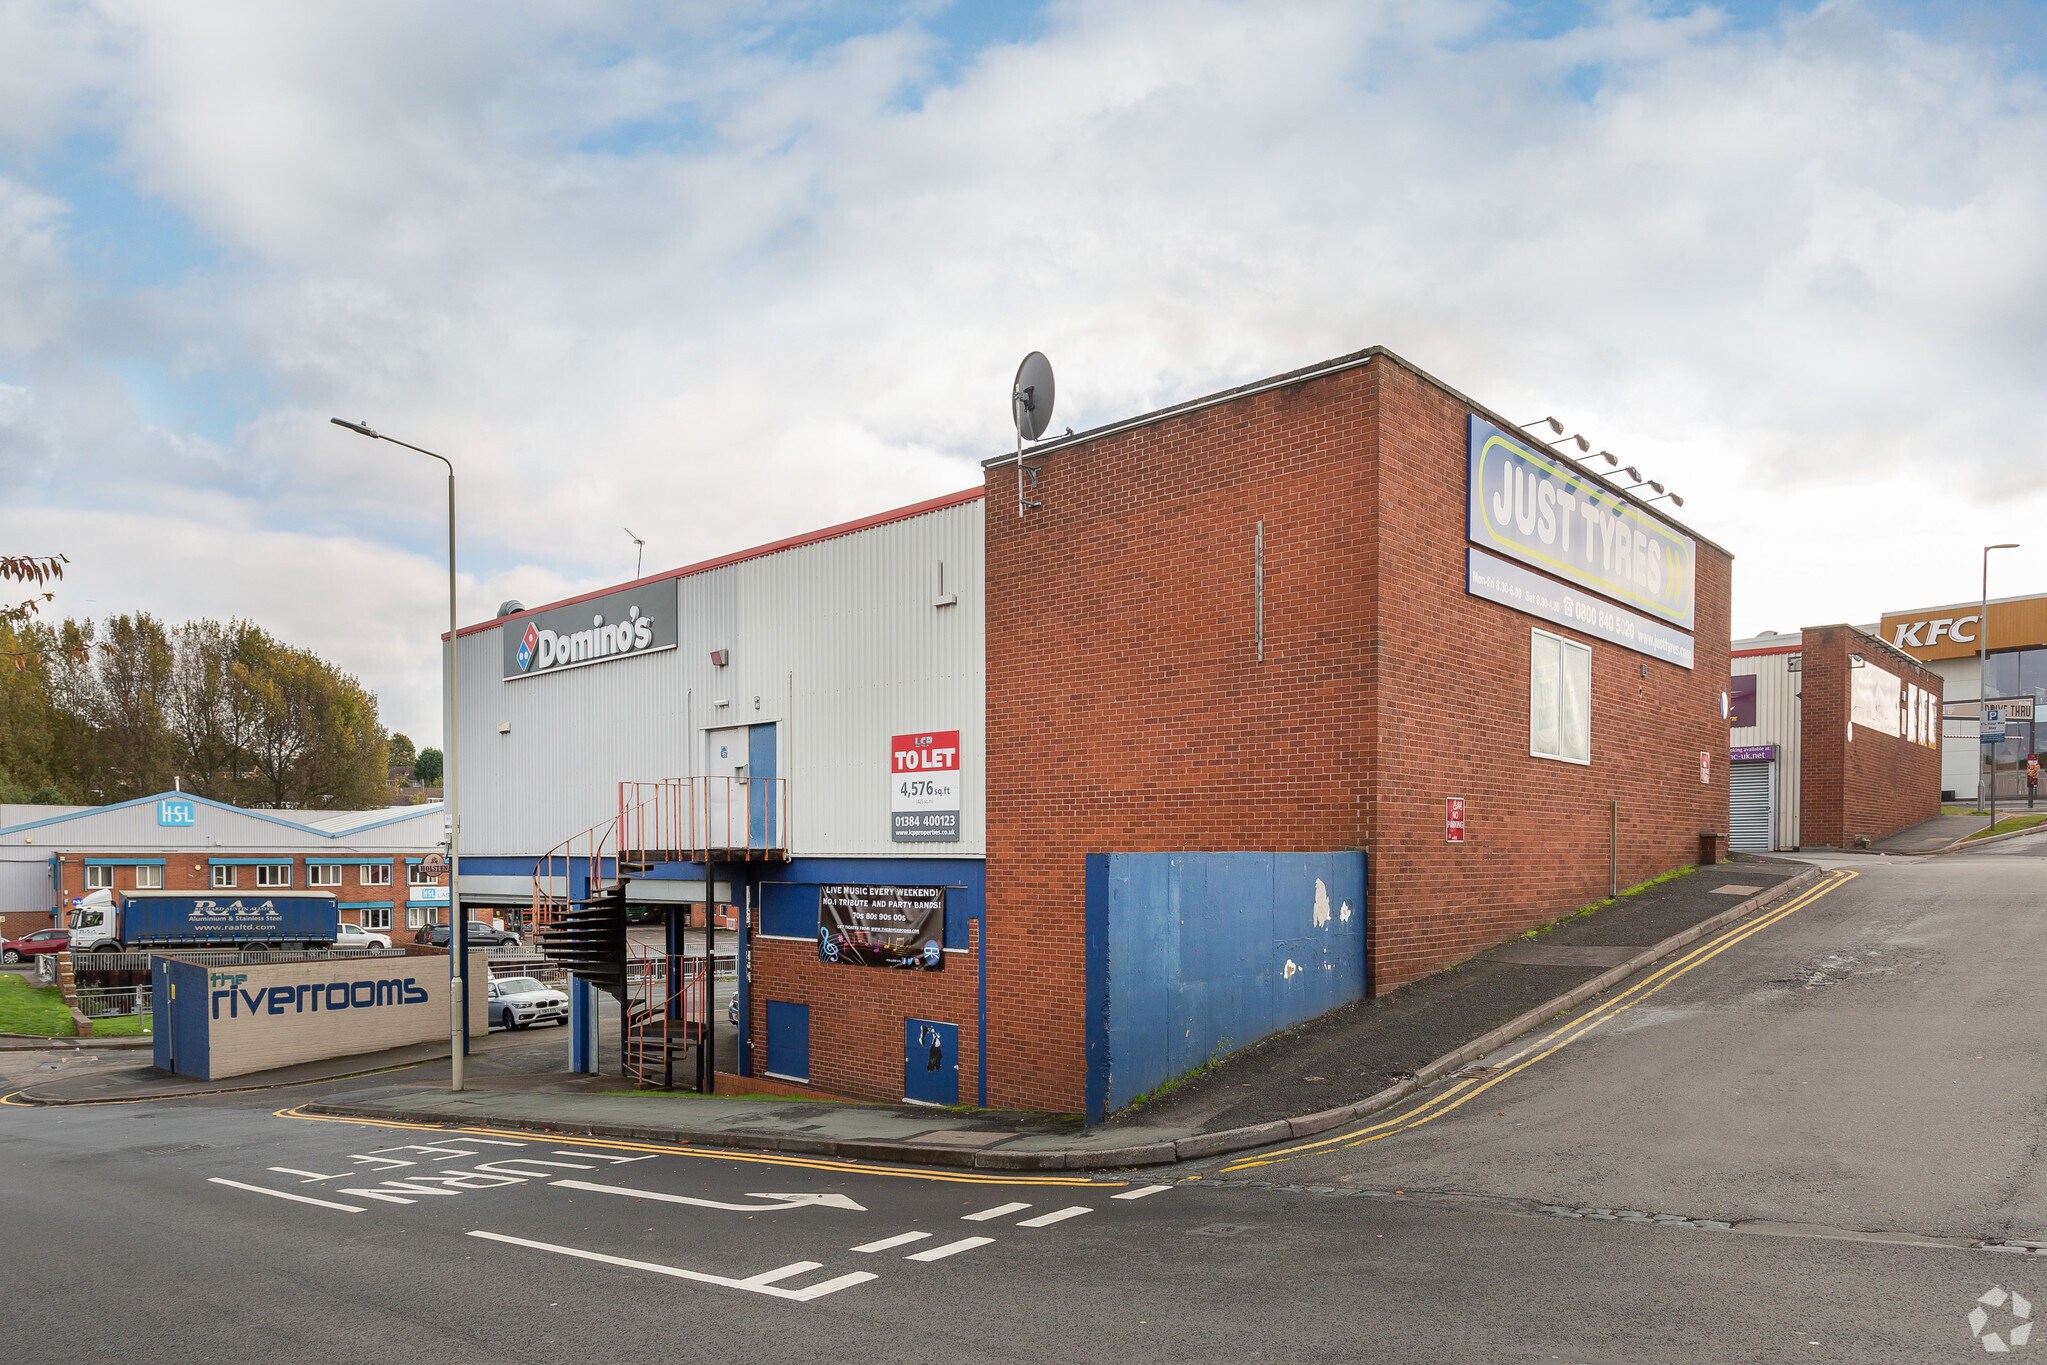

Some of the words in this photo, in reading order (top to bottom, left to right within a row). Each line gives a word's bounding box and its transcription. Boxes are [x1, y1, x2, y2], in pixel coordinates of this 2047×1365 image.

[1493, 460, 1575, 552] JUST
[1581, 501, 1661, 594] TYRES
[1472, 571, 1495, 589] Mon-Fri
[1495, 580, 1522, 599] 8.30-6.00
[1525, 591, 1535, 603] Sat
[1575, 602, 1597, 625] 0800
[1599, 611, 1614, 632] 840
[1616, 618, 1635, 639] 5020
[1637, 631, 1692, 661] www.justtyres.com
[538, 605, 652, 669] Domino's
[1893, 615, 1979, 649] KFC
[2010, 705, 2031, 717] THRU
[915, 736, 933, 747] LCP
[895, 750, 919, 770] TO
[921, 747, 956, 768] LET
[900, 780, 934, 798] 4,576
[934, 786, 950, 797] sq.ft
[162, 801, 195, 822] HSL
[895, 816, 920, 827] 01384
[922, 815, 956, 827] 400123
[826, 886, 842, 894] LIVE
[843, 887, 868, 895] MUSIC
[869, 888, 894, 896] EVERY
[896, 888, 939, 897] WEEKEND!
[188, 900, 280, 916] RAA
[823, 898, 837, 906] NO.1
[839, 899, 868, 907] TRIBUTE
[871, 900, 887, 908] AND
[888, 901, 913, 909] PARTY
[914, 901, 941, 909] BANDS!
[866, 912, 877, 920] 80s
[879, 913, 892, 921] 90s
[210, 972, 248, 987] the
[212, 978, 429, 1020] riverrooms
